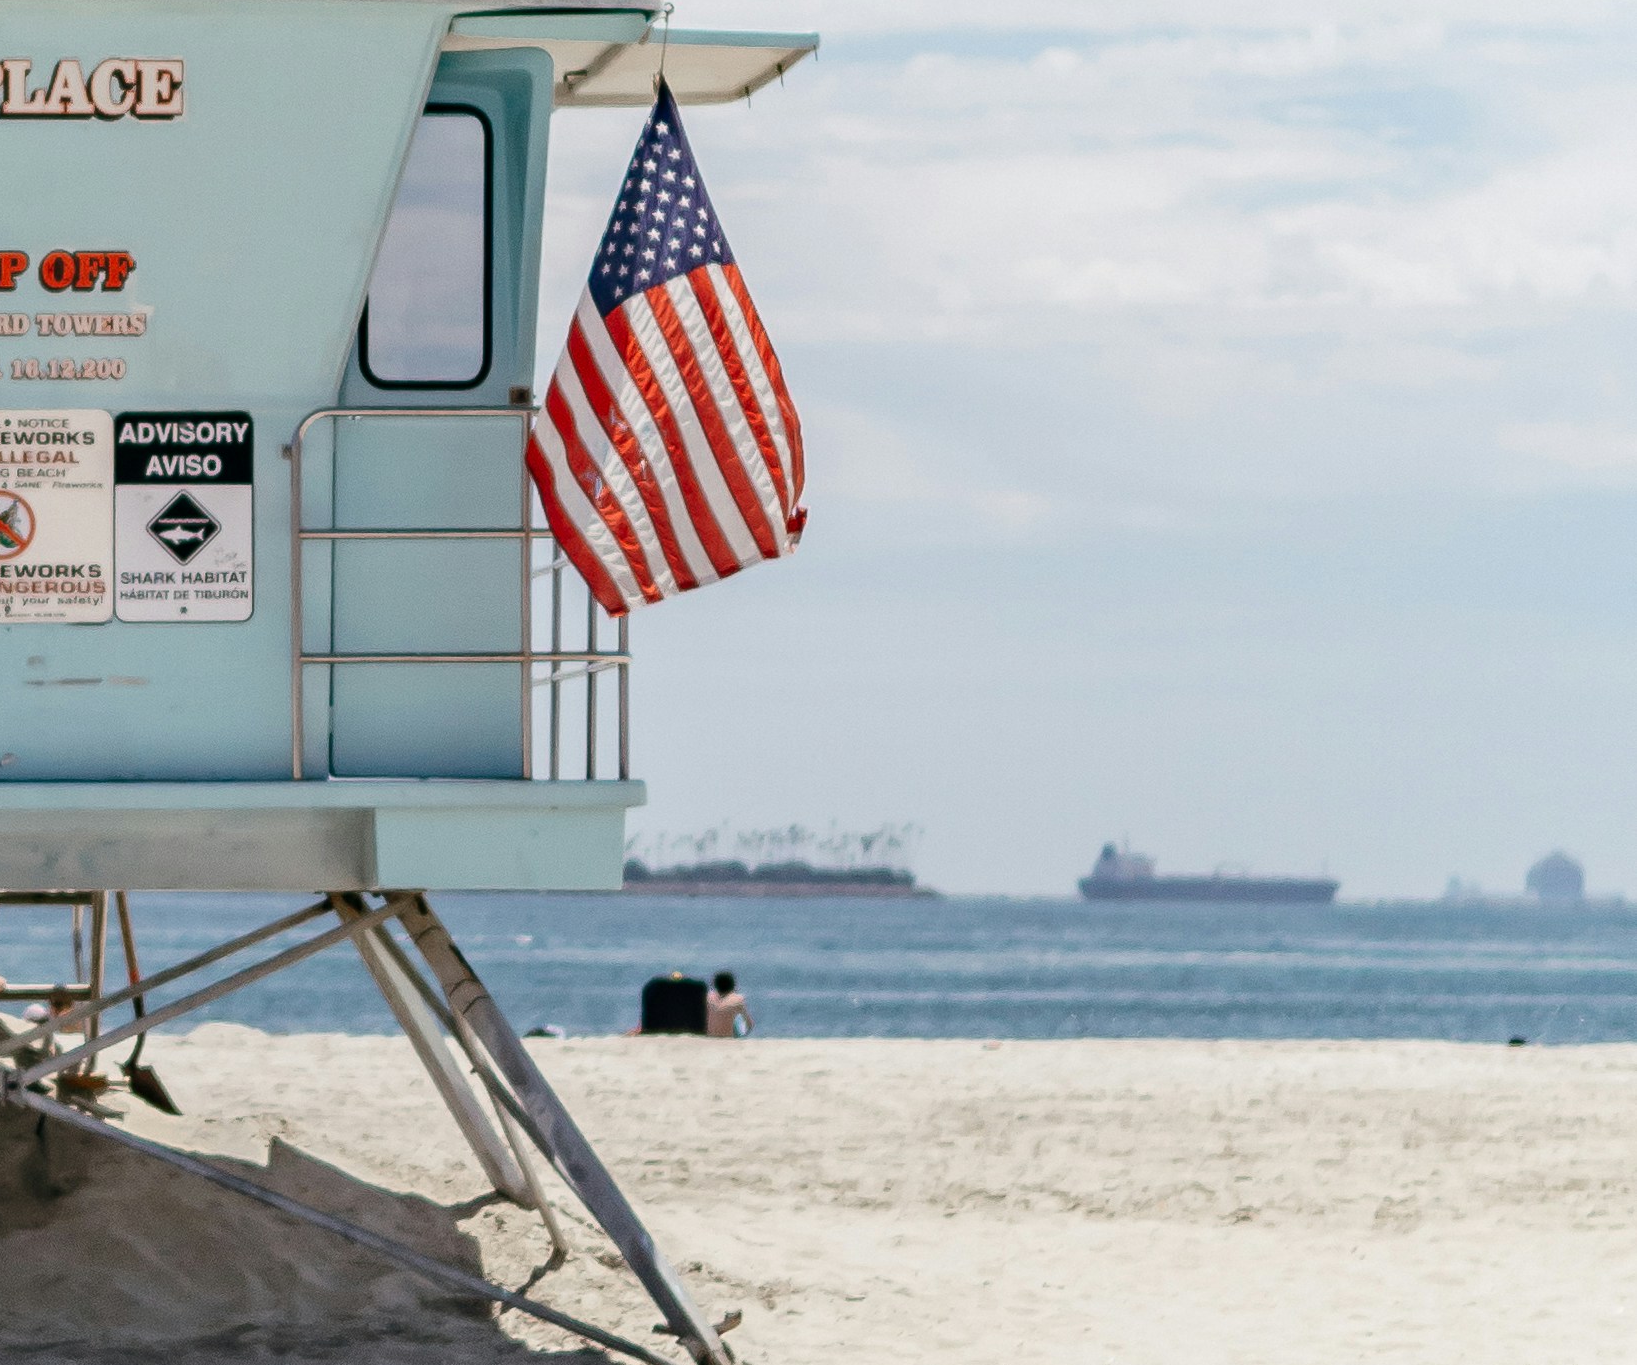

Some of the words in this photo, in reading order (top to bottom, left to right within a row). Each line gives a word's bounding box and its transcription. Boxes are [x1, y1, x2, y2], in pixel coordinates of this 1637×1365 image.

[38, 249, 137, 293] OFF
[35, 313, 147, 336] TOWERS
[17, 419, 70, 429] NOTICE
[118, 421, 249, 444] ADVISORY
[145, 454, 222, 476] AVISO
[16, 468, 66, 478] BEACH
[120, 572, 176, 584] SHARK
[181, 571, 247, 584] HABITAT
[173, 590, 189, 600] DE
[22, 597, 50, 607] your
